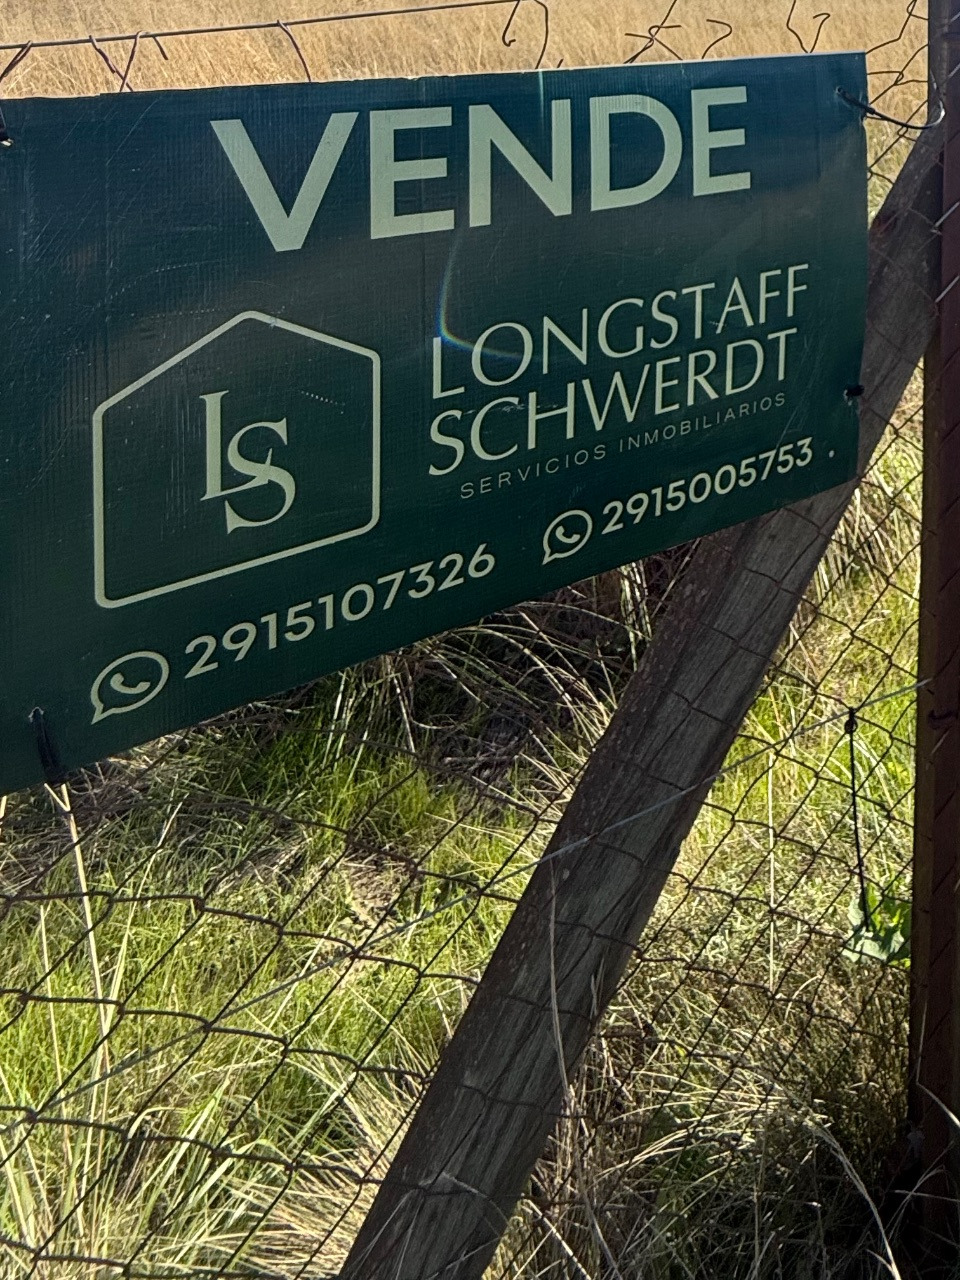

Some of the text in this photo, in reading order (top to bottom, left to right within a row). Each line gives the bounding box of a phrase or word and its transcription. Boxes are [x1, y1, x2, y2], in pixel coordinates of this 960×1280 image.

[210, 86, 752, 251] VENDE
[432, 264, 809, 400] LONGSTAFF
[200, 390, 296, 535] LS
[428, 328, 797, 477] SCHWERDT
[460, 393, 786, 499] SERVICIOS INMOBILIARIOS
[602, 437, 814, 535] 2915005753
[184, 543, 496, 679] 2915107326
